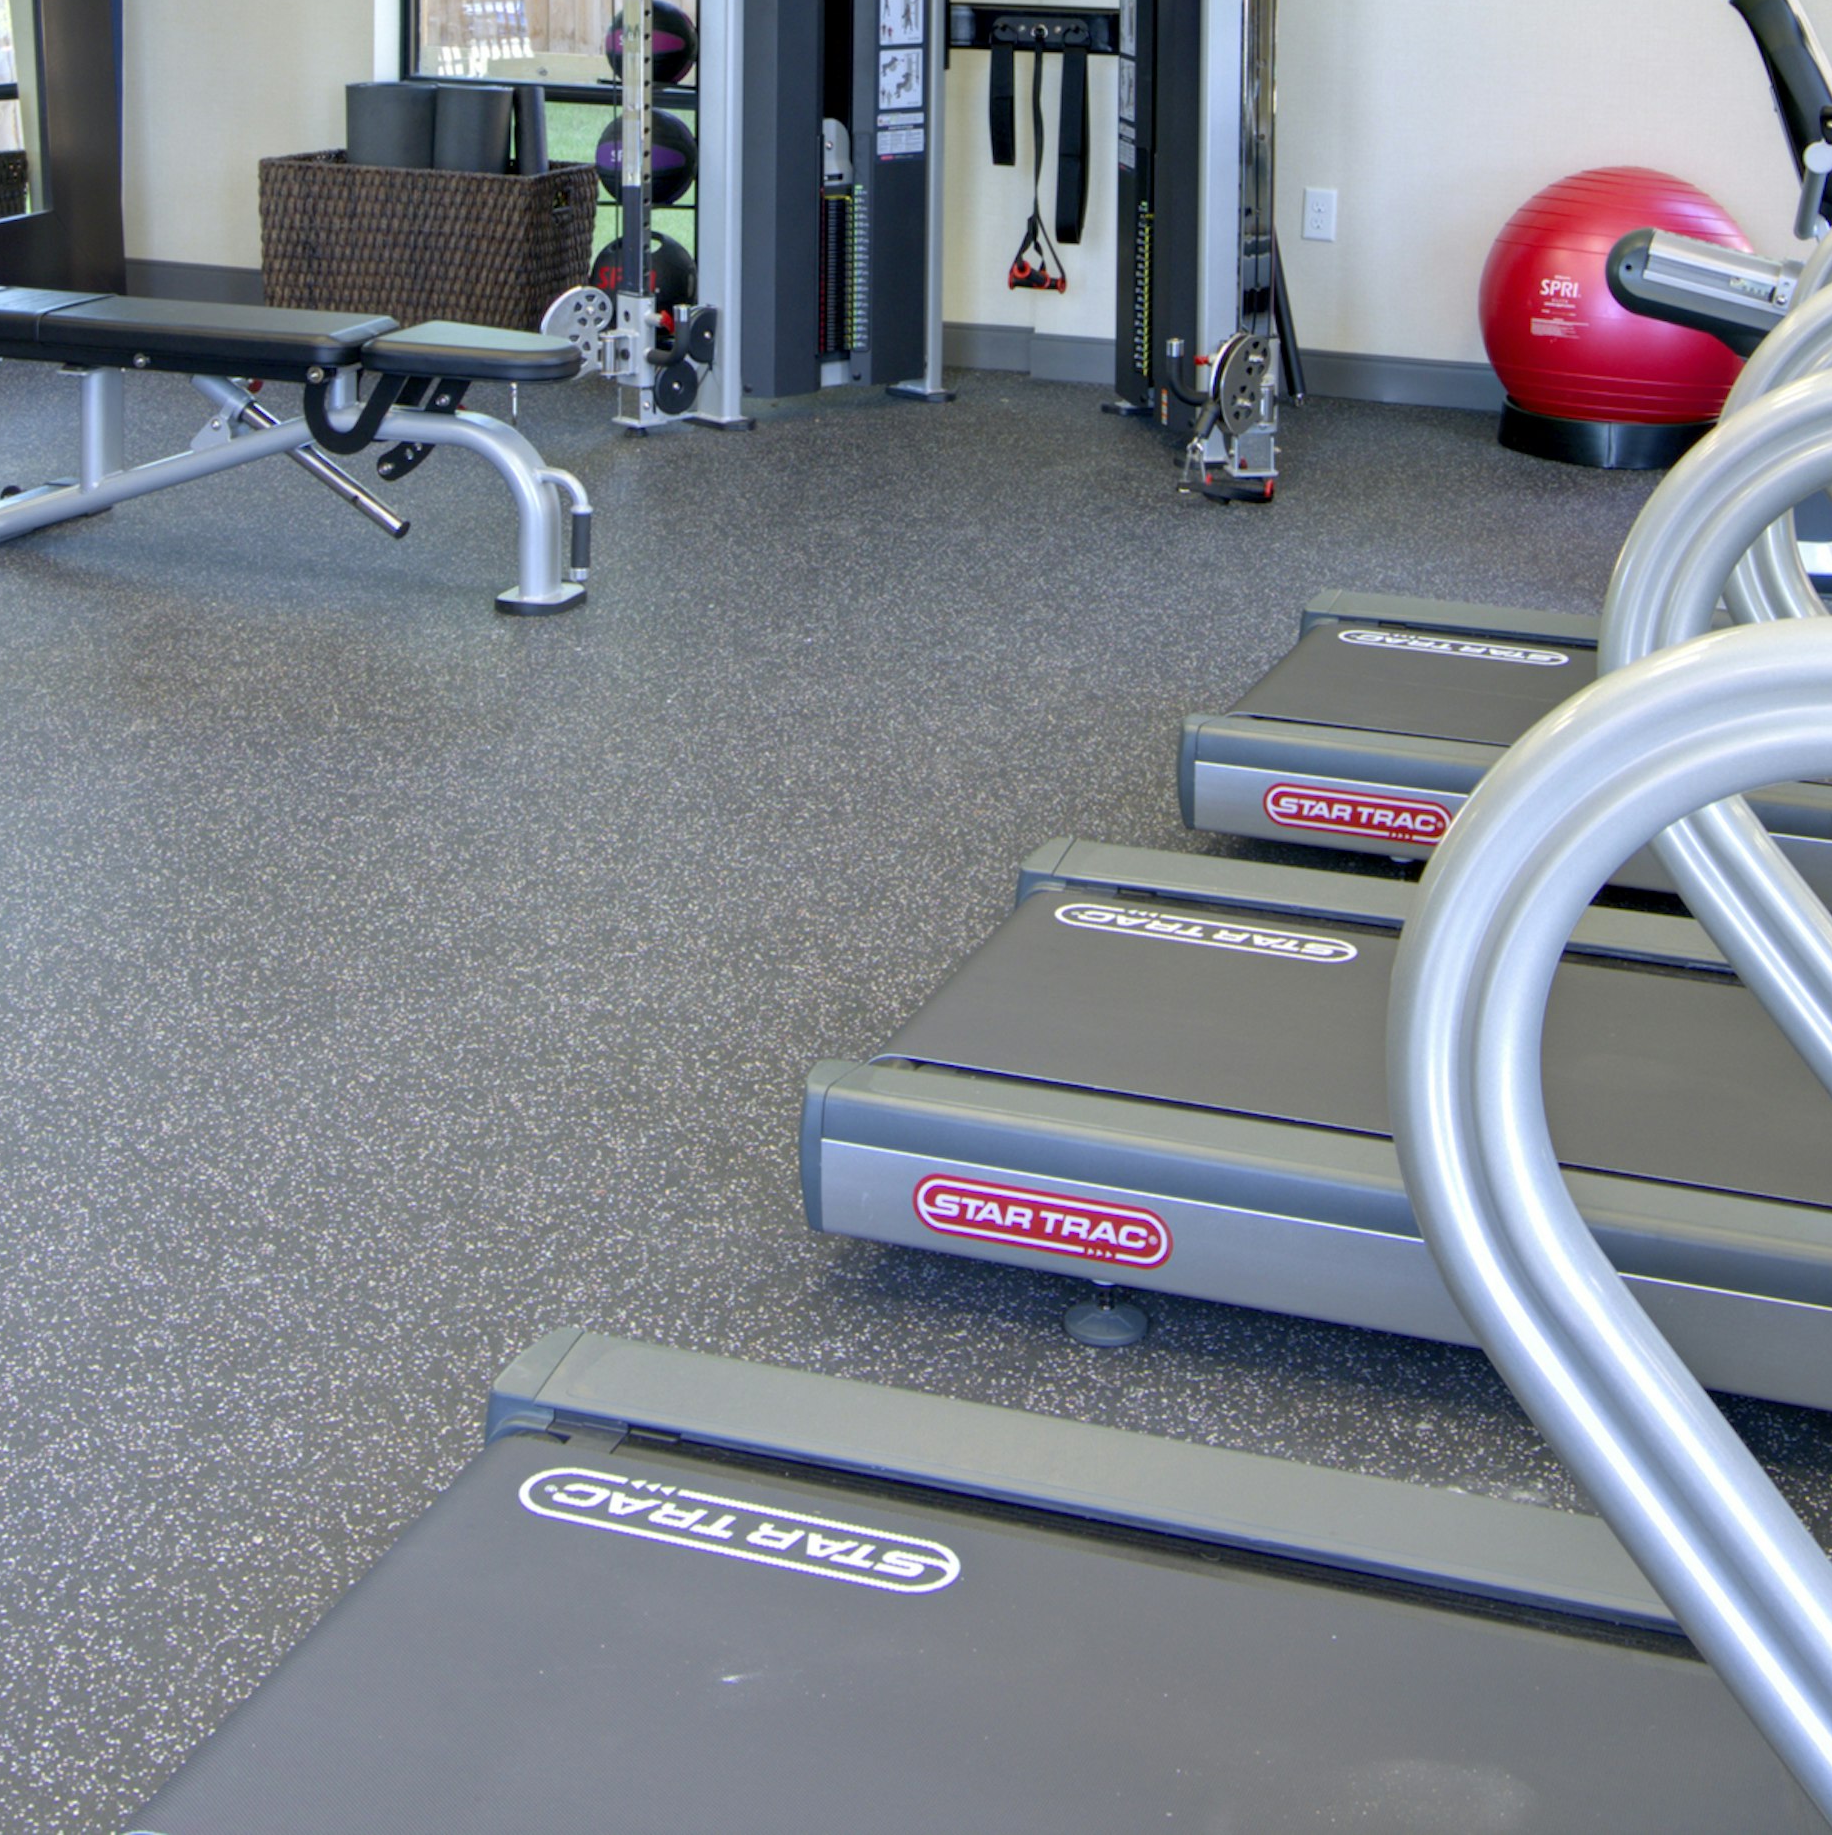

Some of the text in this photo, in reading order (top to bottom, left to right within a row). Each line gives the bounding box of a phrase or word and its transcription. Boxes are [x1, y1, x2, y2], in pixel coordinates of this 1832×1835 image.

[1540, 278, 1579, 299] SPRI
[1355, 633, 1554, 662] STAR TRAC
[1279, 797, 1437, 833] STAR TRAC
[1076, 909, 1335, 957] STAR TRAC
[935, 1193, 1149, 1250] STAR TRAC
[552, 1481, 926, 1578] STAR TRAC
